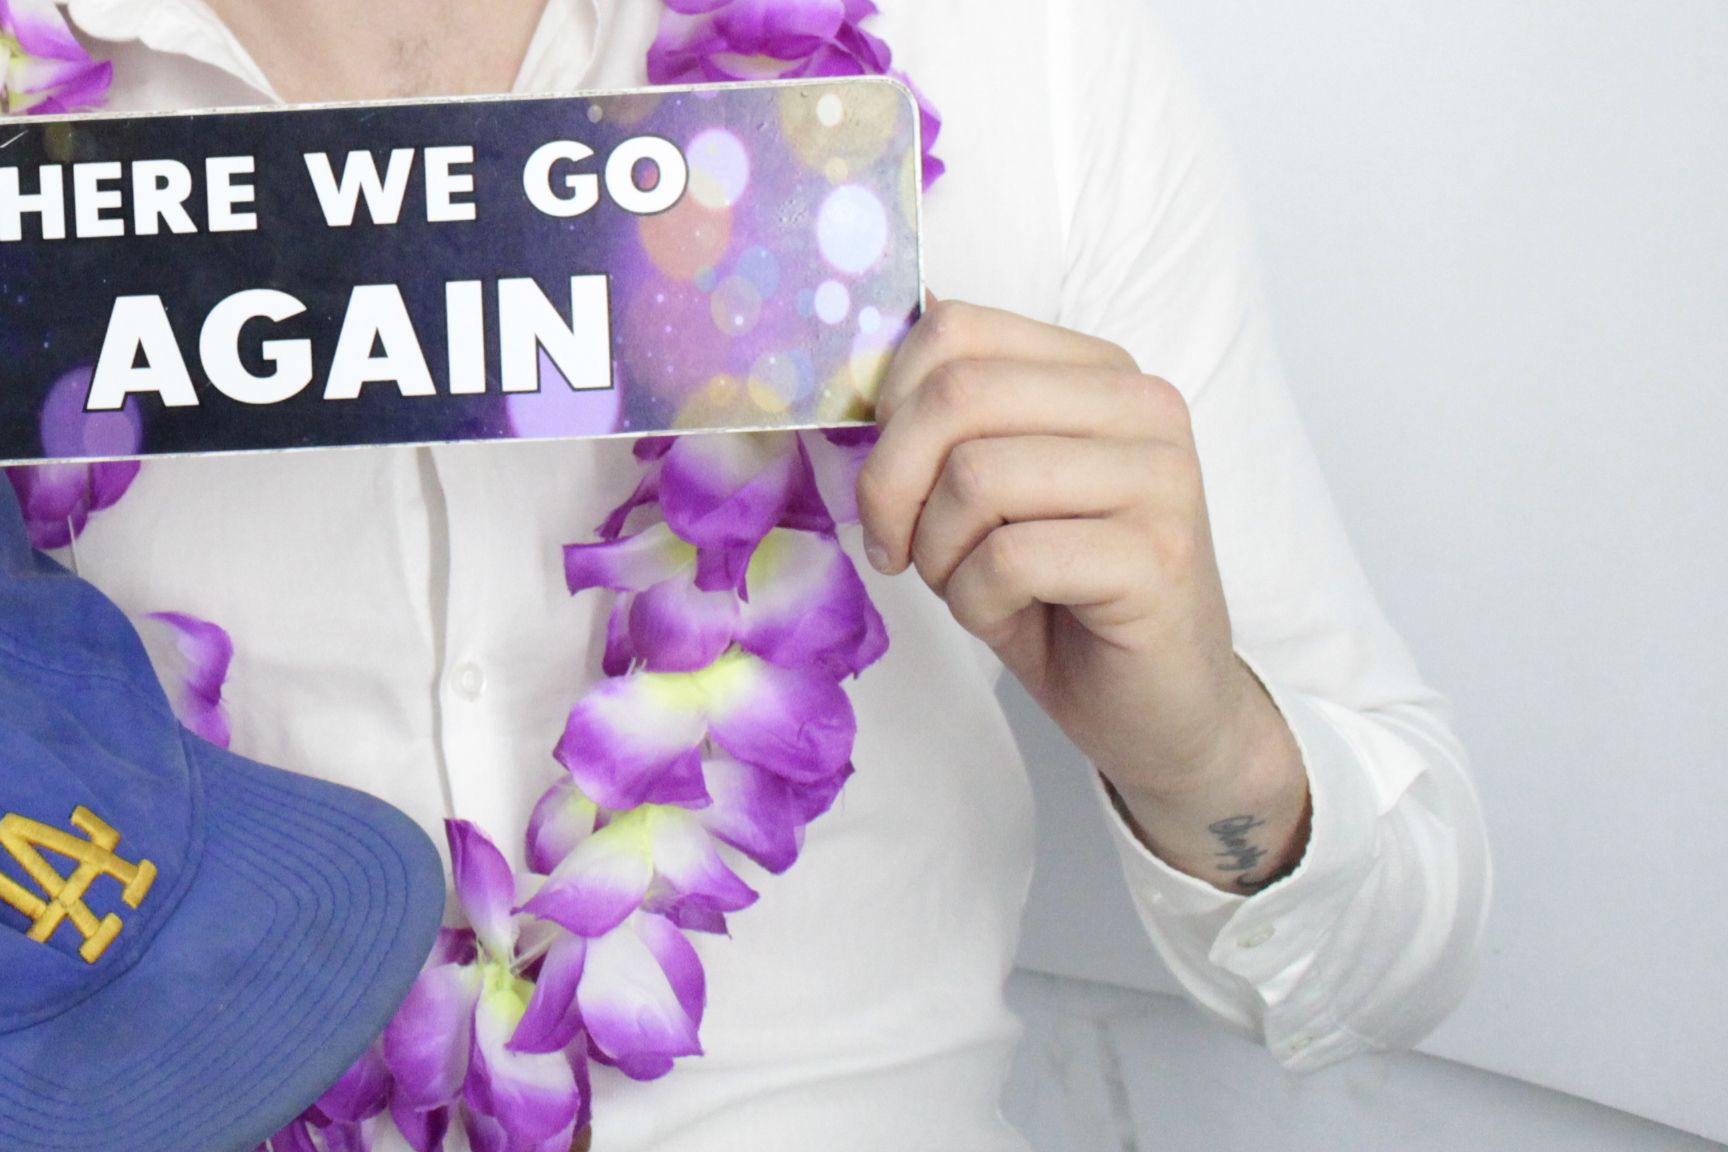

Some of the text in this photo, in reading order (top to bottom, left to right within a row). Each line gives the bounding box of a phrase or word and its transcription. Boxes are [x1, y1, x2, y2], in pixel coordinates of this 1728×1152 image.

[304, 146, 477, 227] WE
[523, 136, 687, 217] GO
[84, 274, 615, 411] AGAIN
